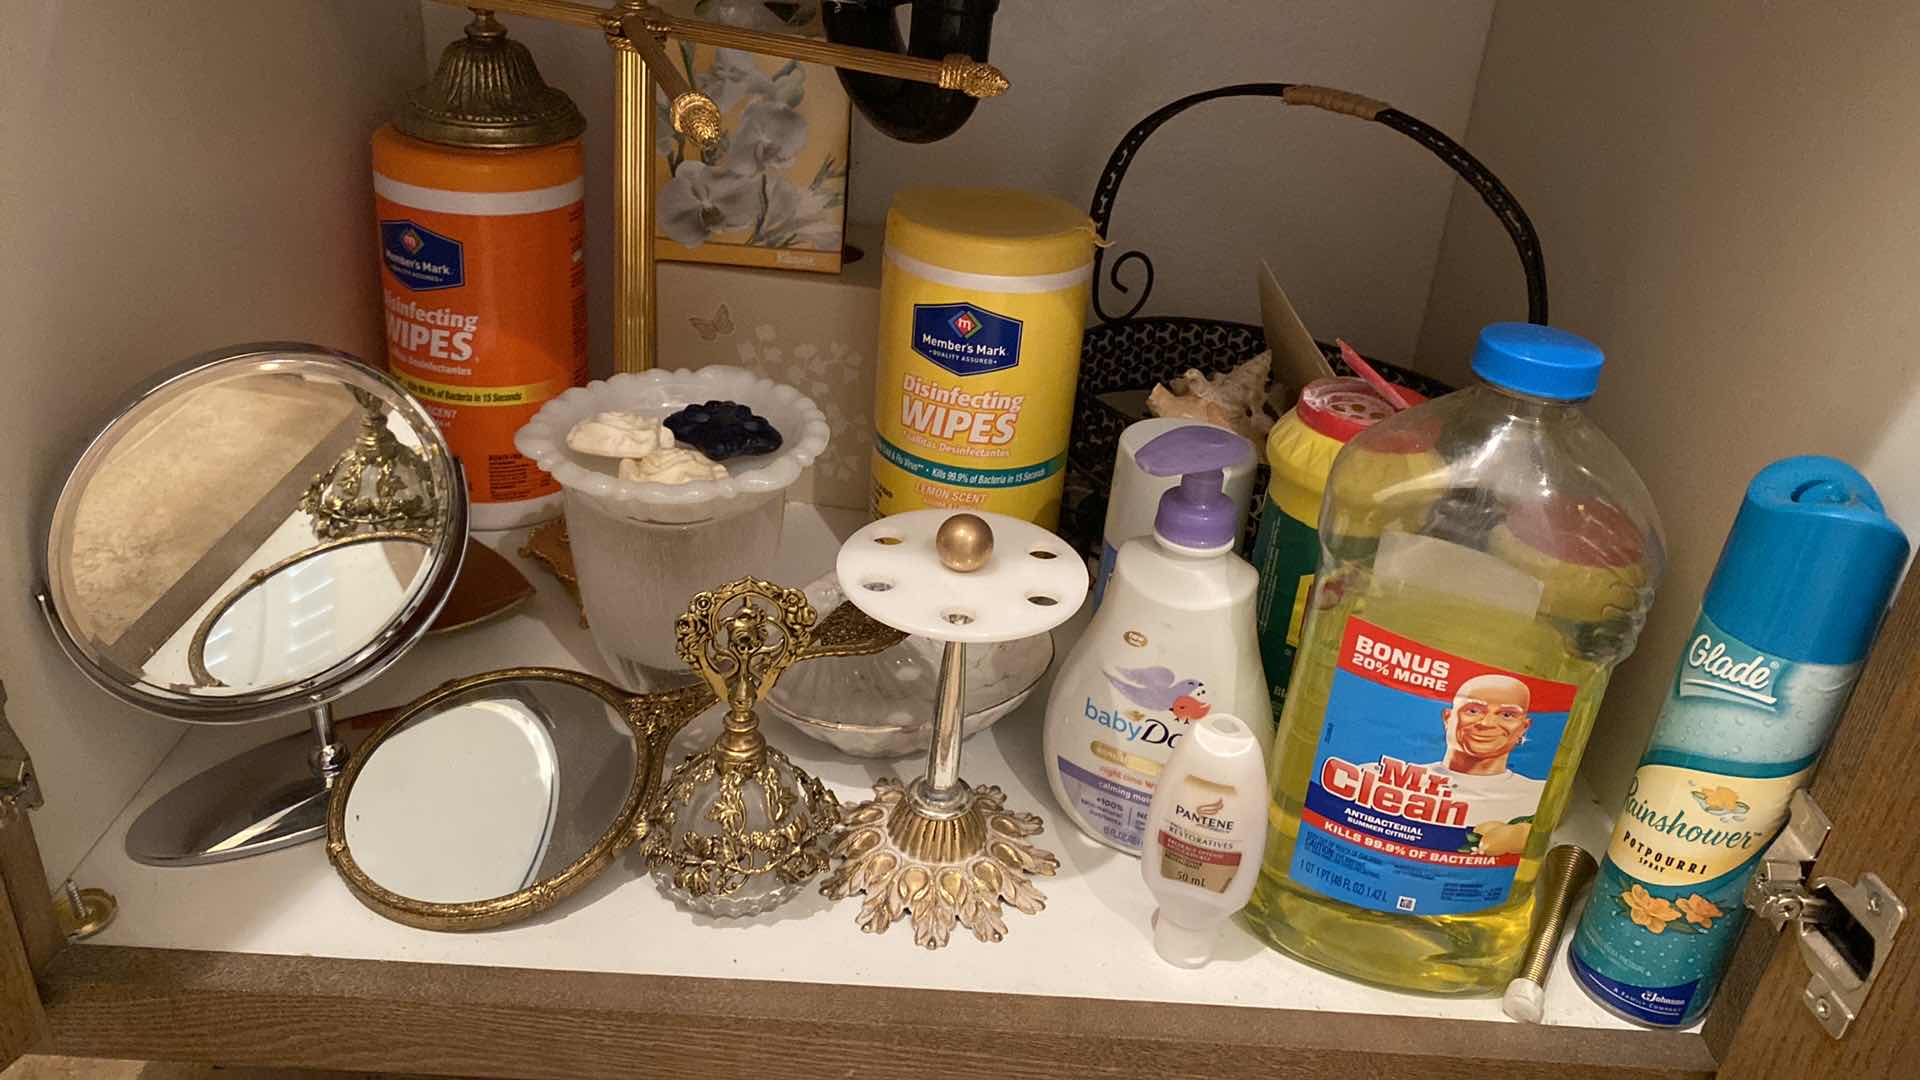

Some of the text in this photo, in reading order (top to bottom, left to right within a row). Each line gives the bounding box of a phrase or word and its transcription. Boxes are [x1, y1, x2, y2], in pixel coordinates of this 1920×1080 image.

[422, 262, 450, 276] Mark
[922, 333, 1006, 357] Member's Mark
[903, 373, 1024, 413] Disinfecting
[901, 395, 1017, 444] WIPES
[947, 471, 969, 484] 99.9%
[978, 474, 1006, 486] Bacteria
[951, 492, 988, 504] SCENT
[1352, 652, 1449, 692] 20% MORE
[1354, 634, 1451, 680] BONUS
[1688, 634, 1771, 690] Glade
[1321, 757, 1470, 827] Clean
[1379, 755, 1453, 799] Mr.
[1175, 803, 1234, 830] PANTENE
[1343, 807, 1424, 837] ANTIBACTERIAL
[1347, 817, 1384, 834] SUMMER
[1168, 825, 1233, 850] RESTORATIVES
[1324, 821, 1362, 842] KILLS
[1364, 836, 1406, 857] 99.9%
[1408, 848, 1428, 860] OF
[1623, 830, 1707, 875] POTPOURRI
[1177, 871, 1189, 883] 50
[1639, 857, 1666, 874] SPRAY
